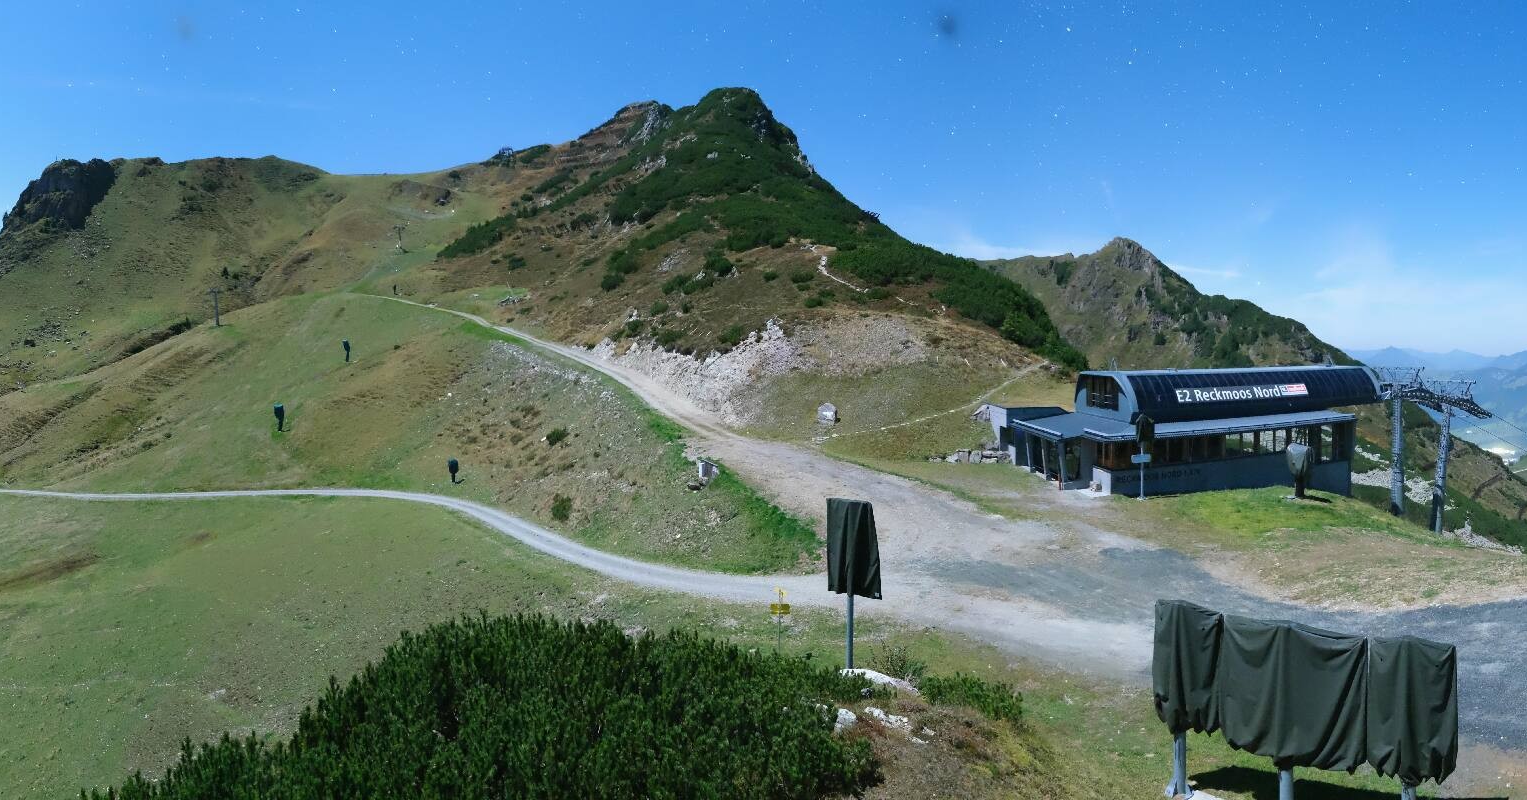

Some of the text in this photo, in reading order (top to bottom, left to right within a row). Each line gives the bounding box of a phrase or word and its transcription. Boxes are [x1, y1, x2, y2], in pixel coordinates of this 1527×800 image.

[1175, 389, 1192, 402] E2
[1194, 388, 1252, 401] Reckmoos
[1253, 385, 1281, 398] Nord
